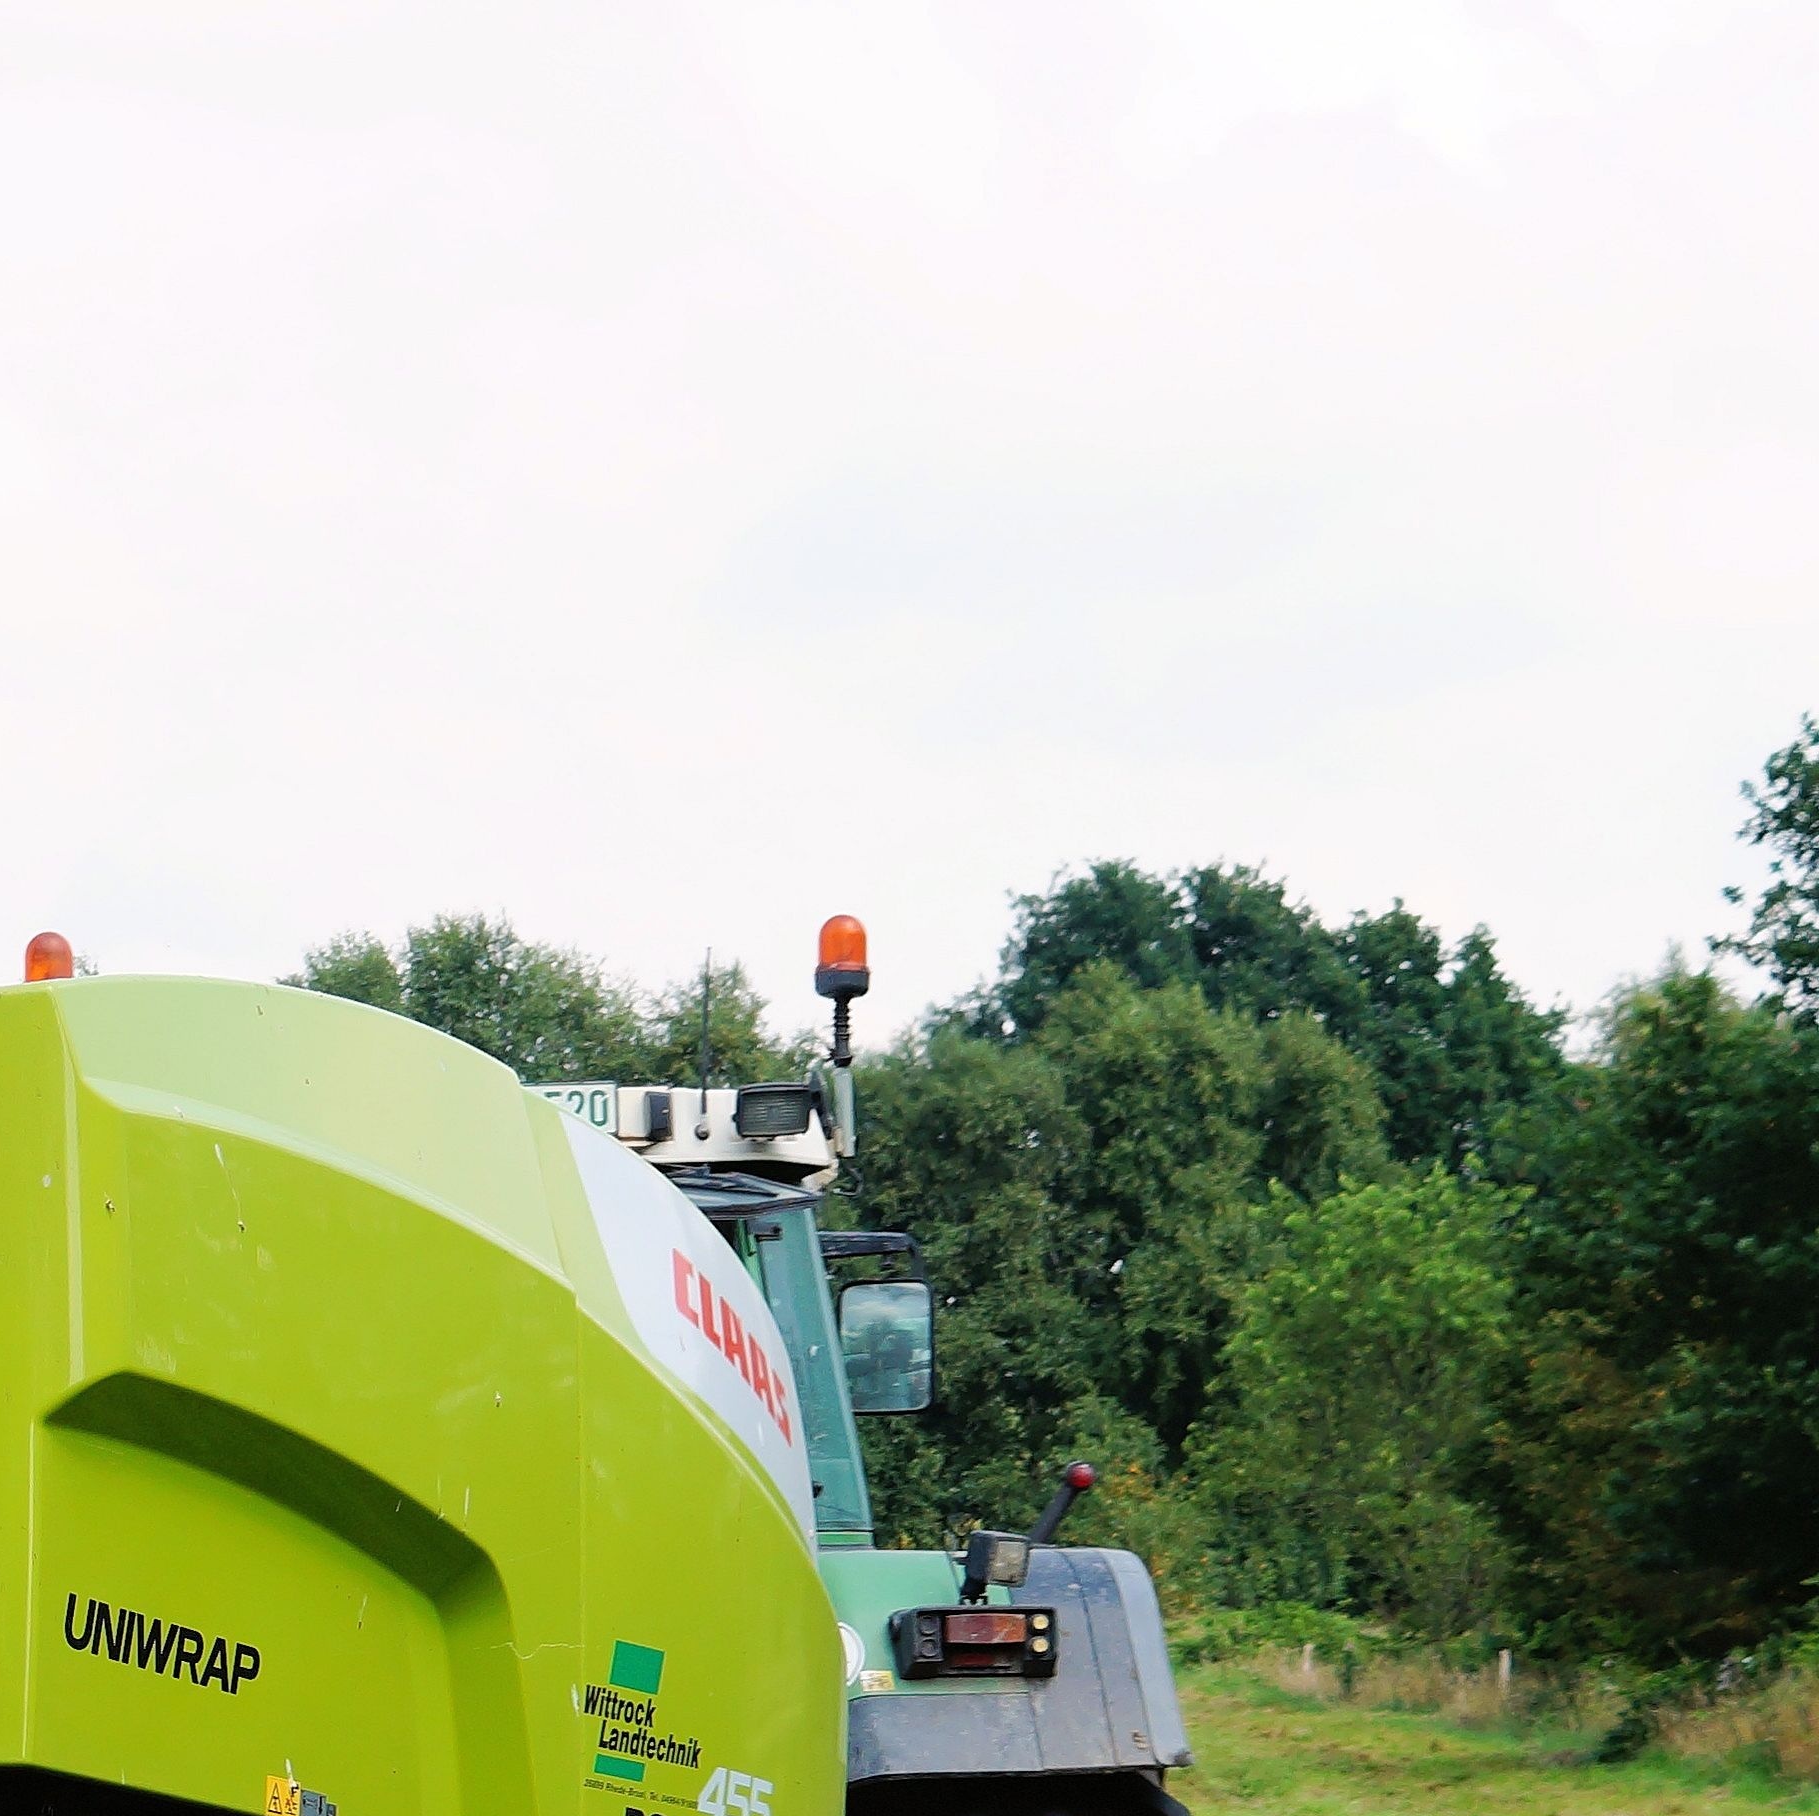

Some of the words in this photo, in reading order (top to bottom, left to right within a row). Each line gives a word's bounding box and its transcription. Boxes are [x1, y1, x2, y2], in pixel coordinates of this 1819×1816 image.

[544, 1090, 608, 1127] 20
[672, 1247, 793, 1448] CLAAS
[64, 1592, 262, 1696] UNIWRAP
[583, 1684, 657, 1728] Wittrock
[598, 1720, 702, 1769] Landtechnik
